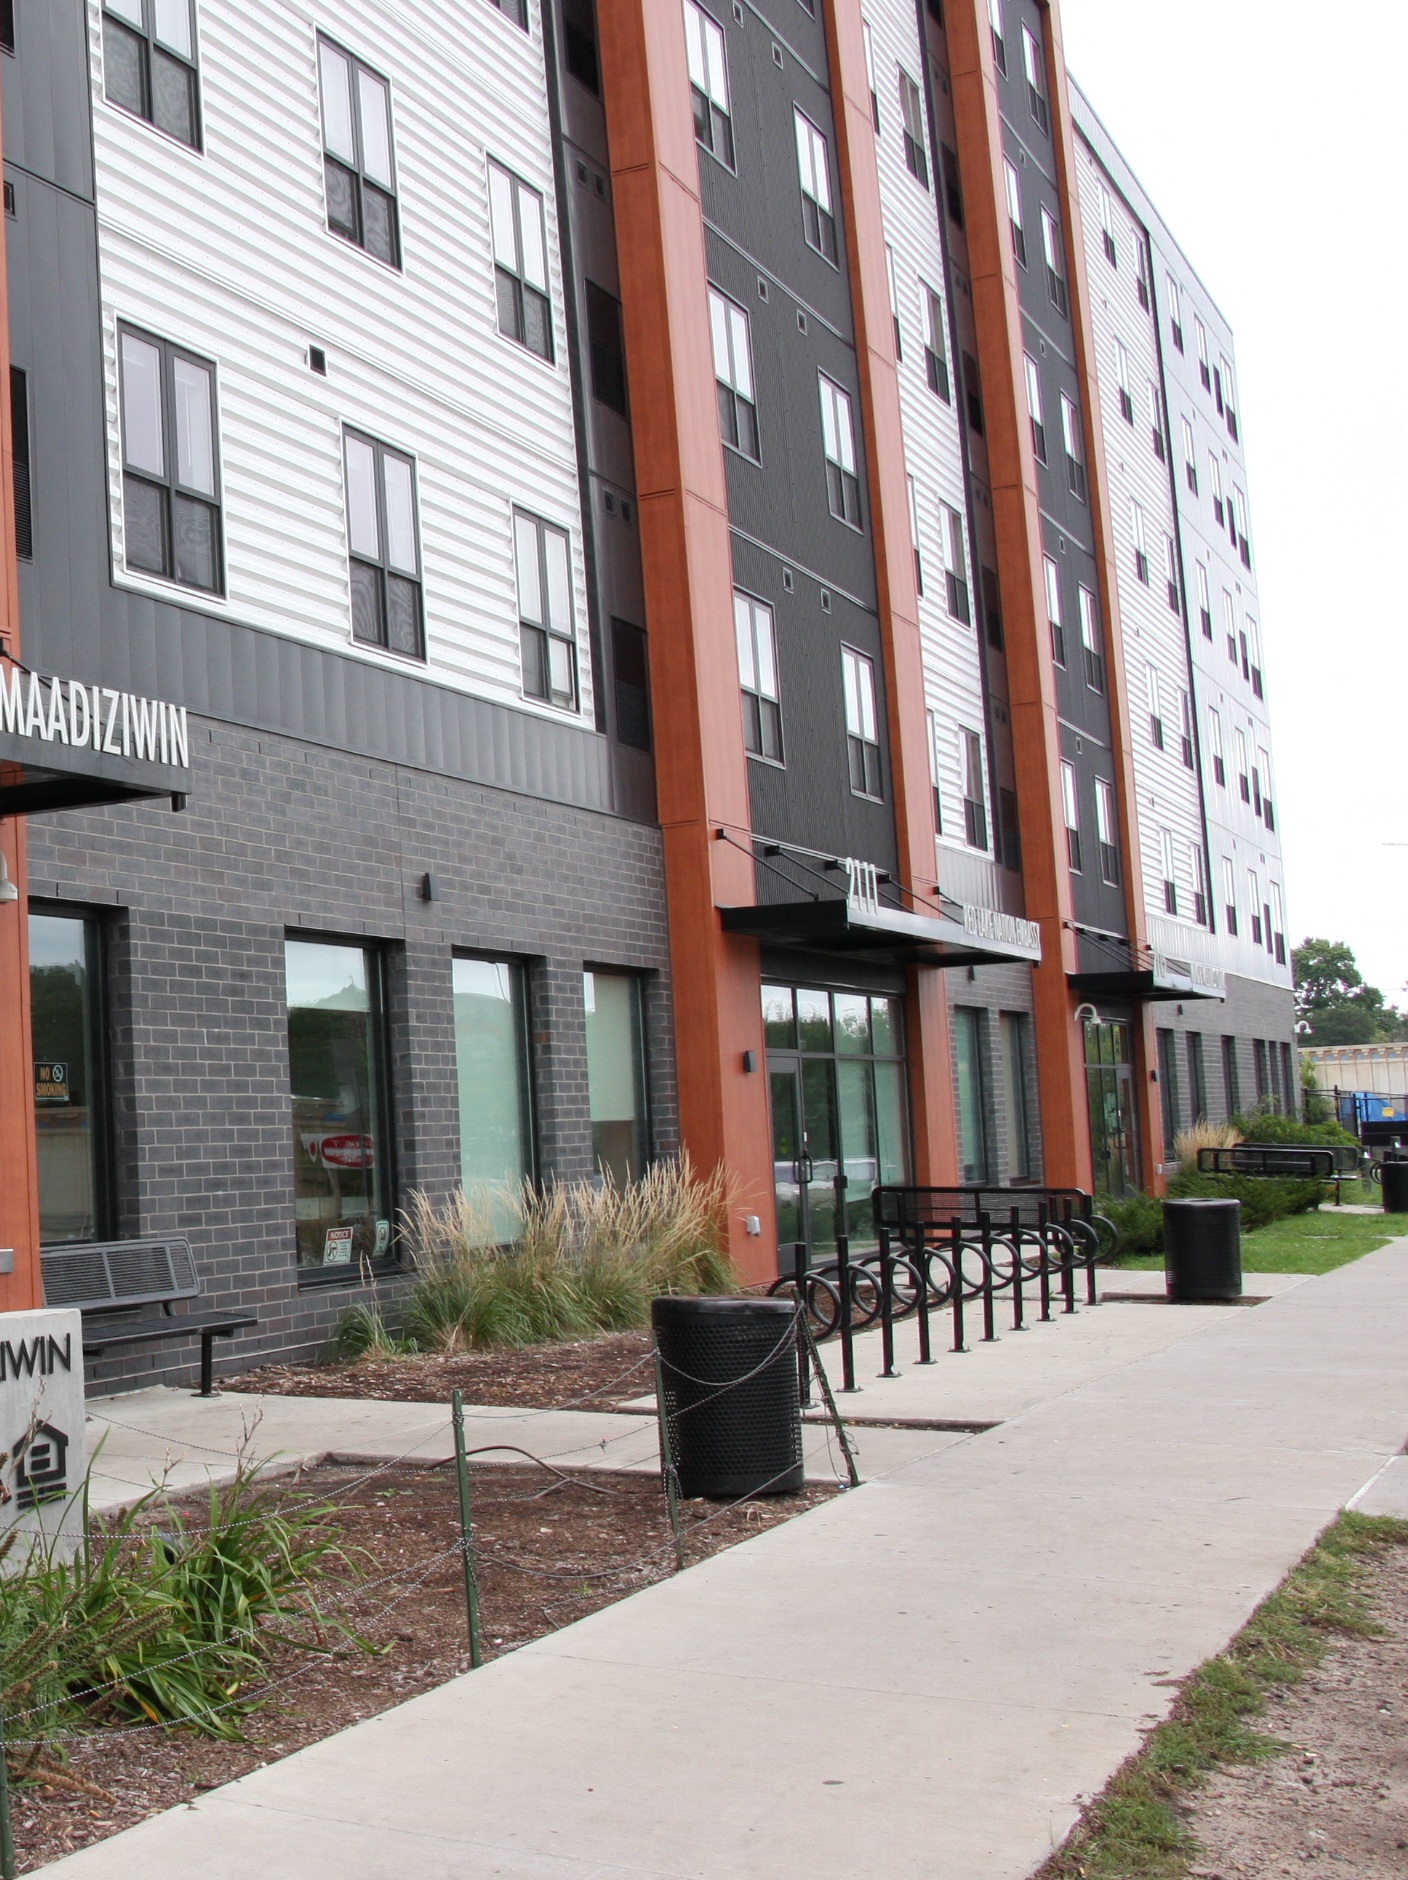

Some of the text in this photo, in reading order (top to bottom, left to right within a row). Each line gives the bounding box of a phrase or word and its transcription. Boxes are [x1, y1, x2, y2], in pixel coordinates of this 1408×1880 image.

[40, 1066, 50, 1080] NO
[36, 1082, 66, 1097] SMOKING
[329, 1230, 350, 1240] NOTICE
